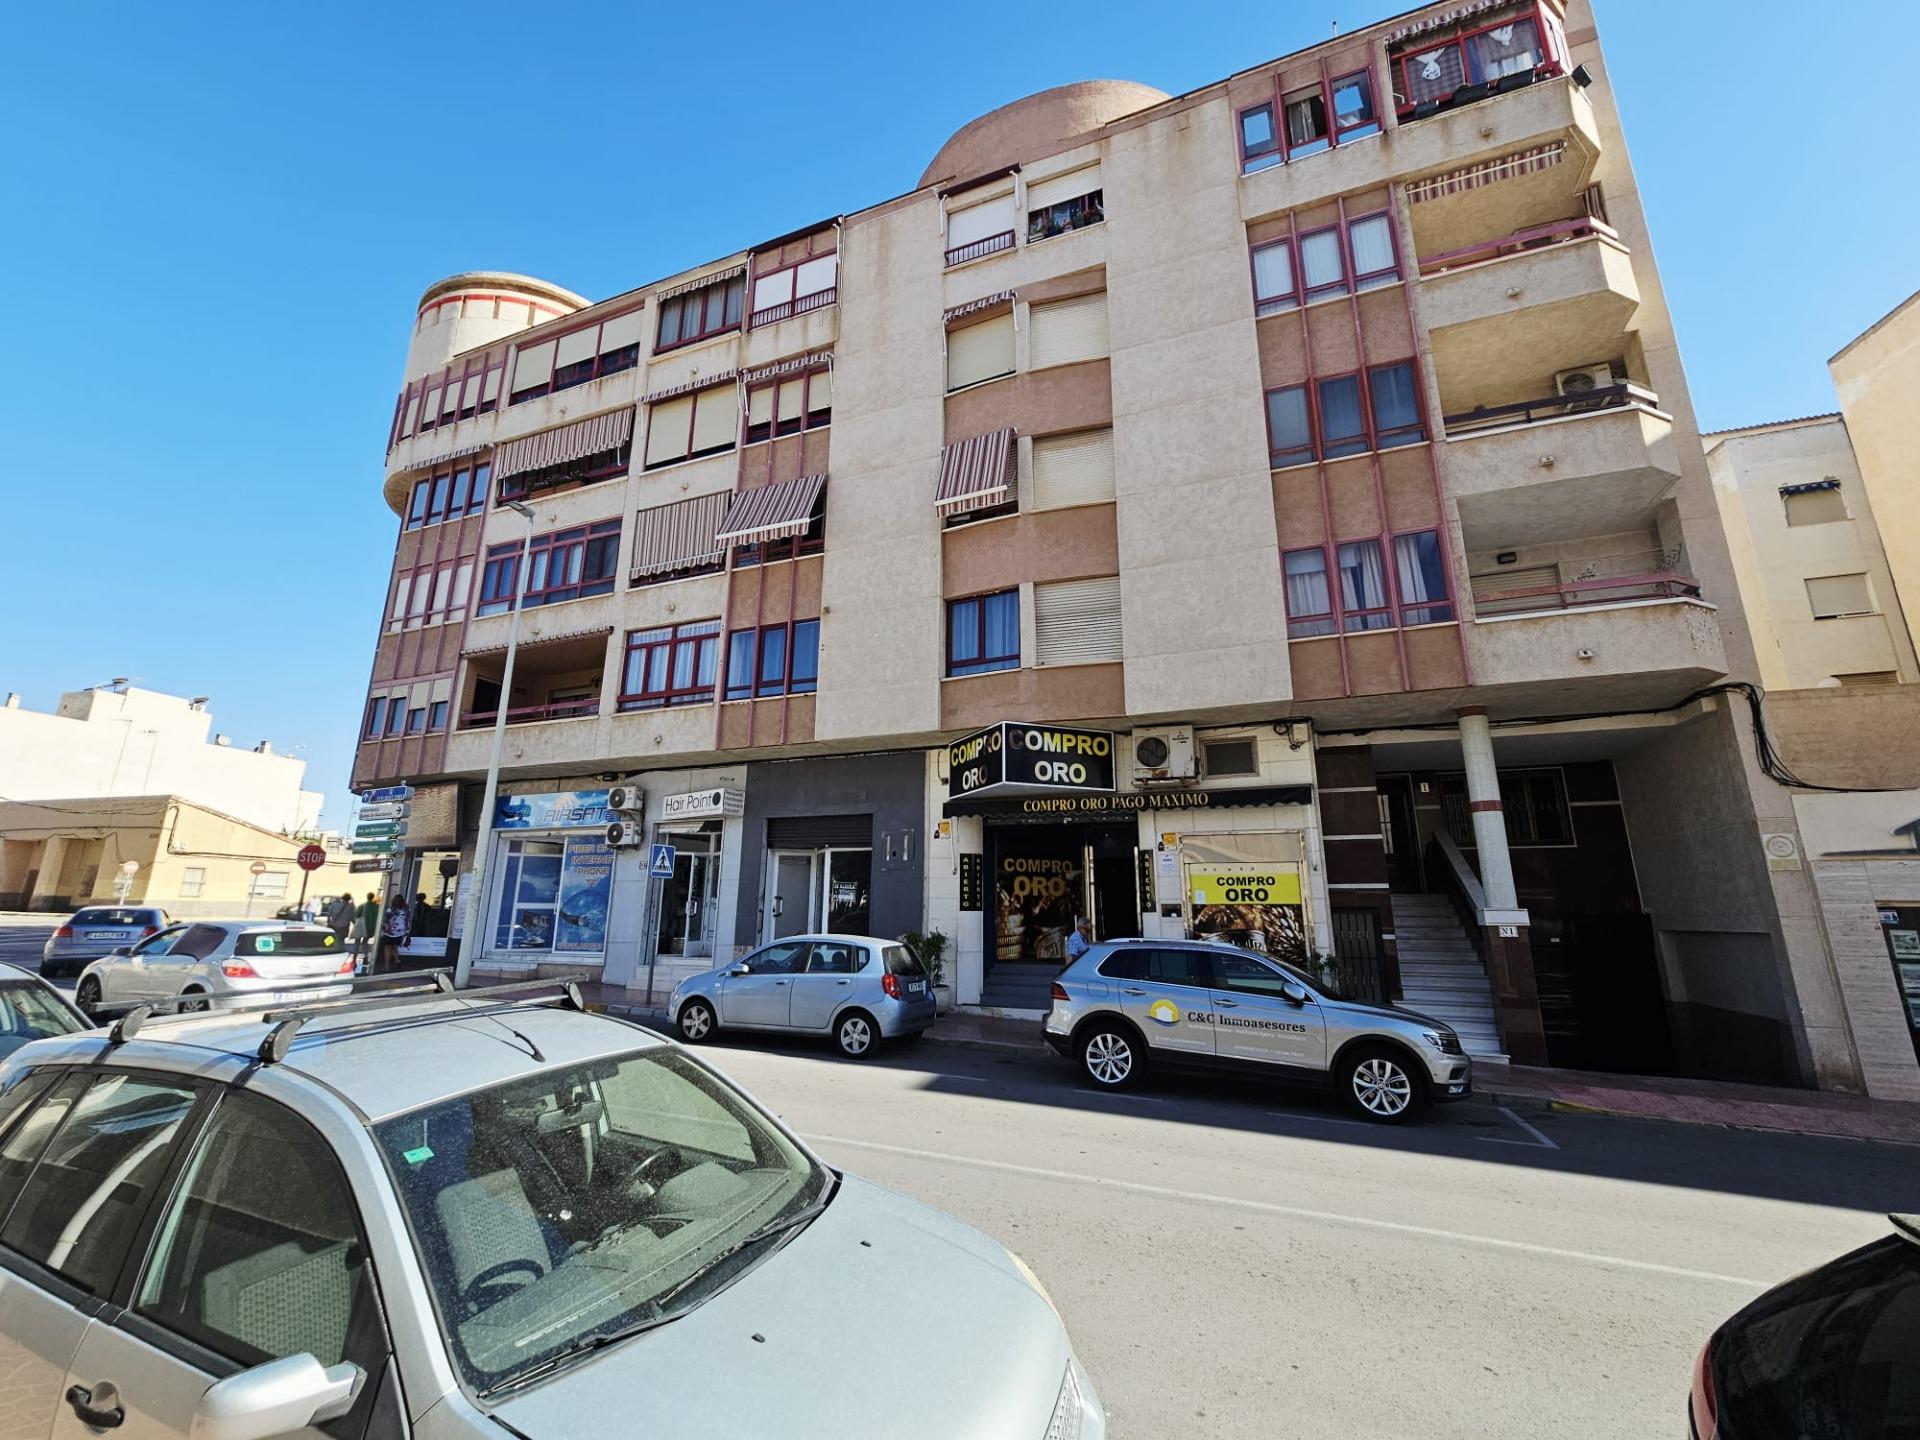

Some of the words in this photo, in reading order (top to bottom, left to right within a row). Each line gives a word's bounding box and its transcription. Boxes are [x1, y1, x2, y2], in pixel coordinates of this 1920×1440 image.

[951, 730, 1001, 766] COMPRO
[1008, 728, 1110, 757] COMPRO
[962, 764, 988, 790] ORO
[1034, 760, 1087, 784] ORO
[665, 797, 685, 812] Hair
[686, 793, 712, 810] Point
[1023, 799, 1076, 812] COMPRO
[1080, 797, 1107, 810] ORO
[1112, 795, 1145, 809] PAGO
[1149, 791, 1209, 807] MAXIMO
[300, 851, 325, 864] STOP
[568, 844, 595, 854] FIBER
[571, 854, 615, 865] INTERNE
[1003, 857, 1073, 873] COMPRO
[576, 866, 609, 876] PHONE
[584, 879, 600, 888] TV
[962, 856, 970, 908] ABIERTO
[1013, 875, 1066, 897] ORO
[1216, 876, 1276, 887] COMPRO
[1225, 888, 1269, 902] ORO
[1187, 1011, 1215, 1025] C&C
[1219, 1014, 1307, 1033] Inmoasesores
